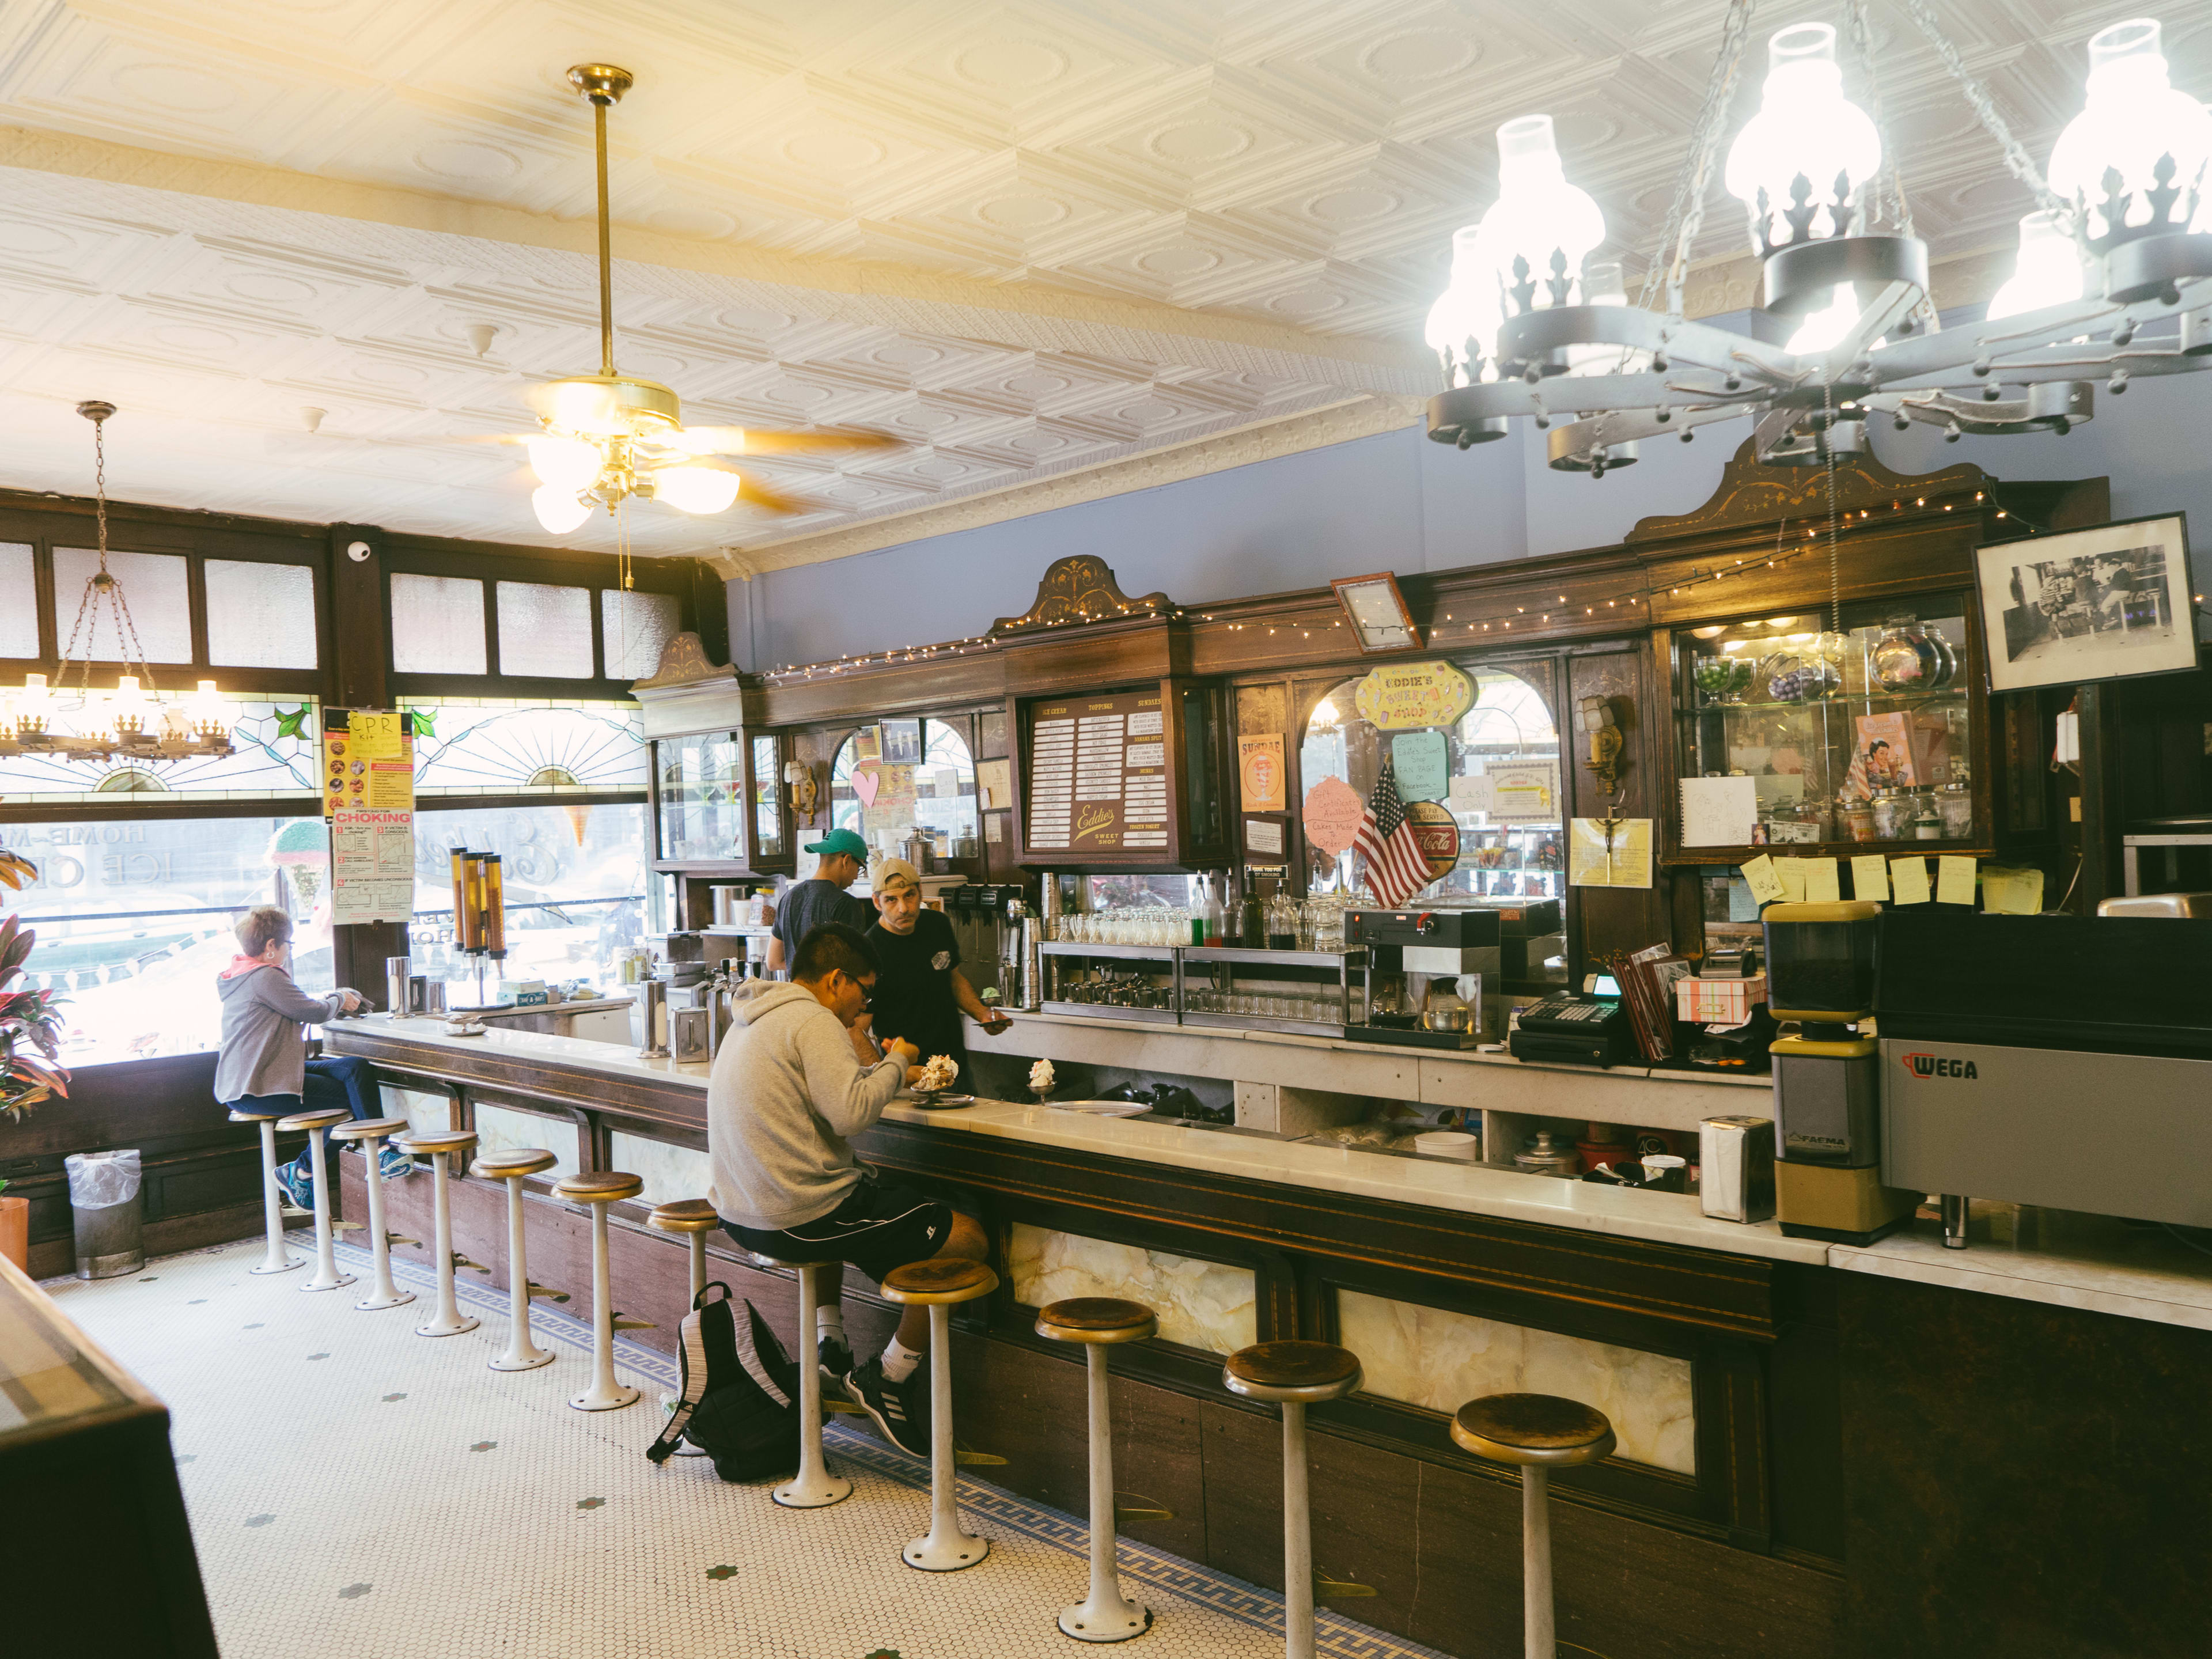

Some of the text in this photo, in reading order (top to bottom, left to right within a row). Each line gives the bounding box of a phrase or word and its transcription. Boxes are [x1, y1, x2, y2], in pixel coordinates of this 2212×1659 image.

[1386, 675, 1433, 688] EDDIE'S
[1386, 690, 1428, 704] SWEET
[1088, 703, 1113, 711] TOPPINGS
[1394, 707, 1427, 718] SHOP
[351, 716, 393, 733] CPR
[1395, 737, 1412, 747] Join
[1243, 741, 1280, 756] SUNDAE
[1423, 747, 1441, 755] Sweet
[1313, 789, 1330, 800] Gift
[1456, 783, 1488, 798] Cash
[1463, 801, 1486, 810] Only
[335, 813, 411, 823] CHOKING
[1077, 804, 1115, 830] Eddie's
[1324, 808, 1357, 818] Available
[1312, 821, 1332, 831] Cakes
[1319, 838, 1342, 847] Order
[1914, 1056, 1978, 1080] WEGA
[1801, 1135, 1846, 1146] FAEMA
